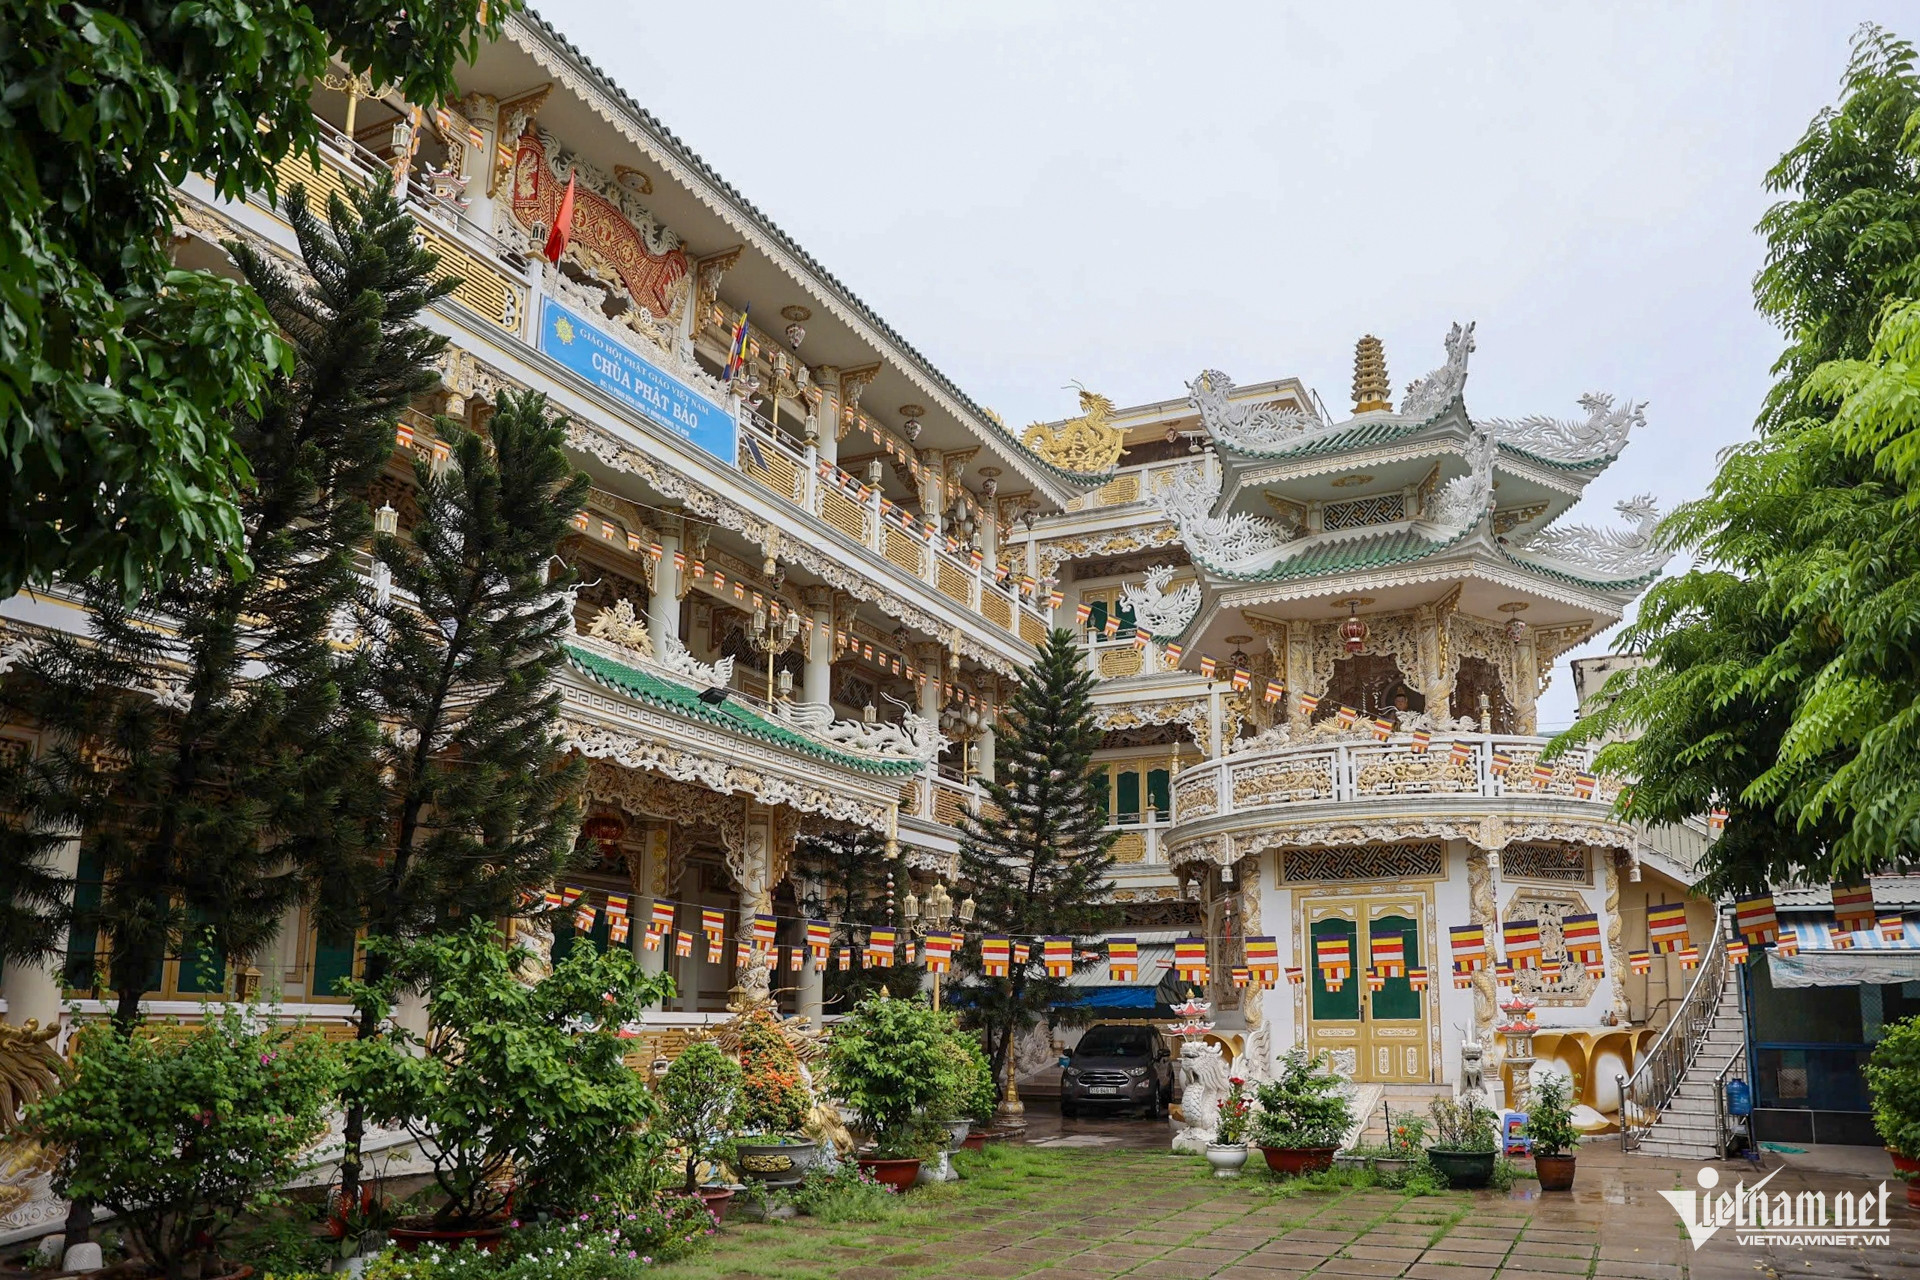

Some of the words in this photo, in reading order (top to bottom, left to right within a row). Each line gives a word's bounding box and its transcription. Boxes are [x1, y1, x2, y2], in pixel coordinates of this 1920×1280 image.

[580, 328, 604, 348] GIÁO
[606, 344, 622, 360] HỘI
[648, 372, 670, 389] GIÁO
[691, 398, 709, 416] NAM
[592, 352, 631, 389] CHÙA
[634, 377, 670, 413] PHẬT
[672, 402, 698, 429] BẢO
